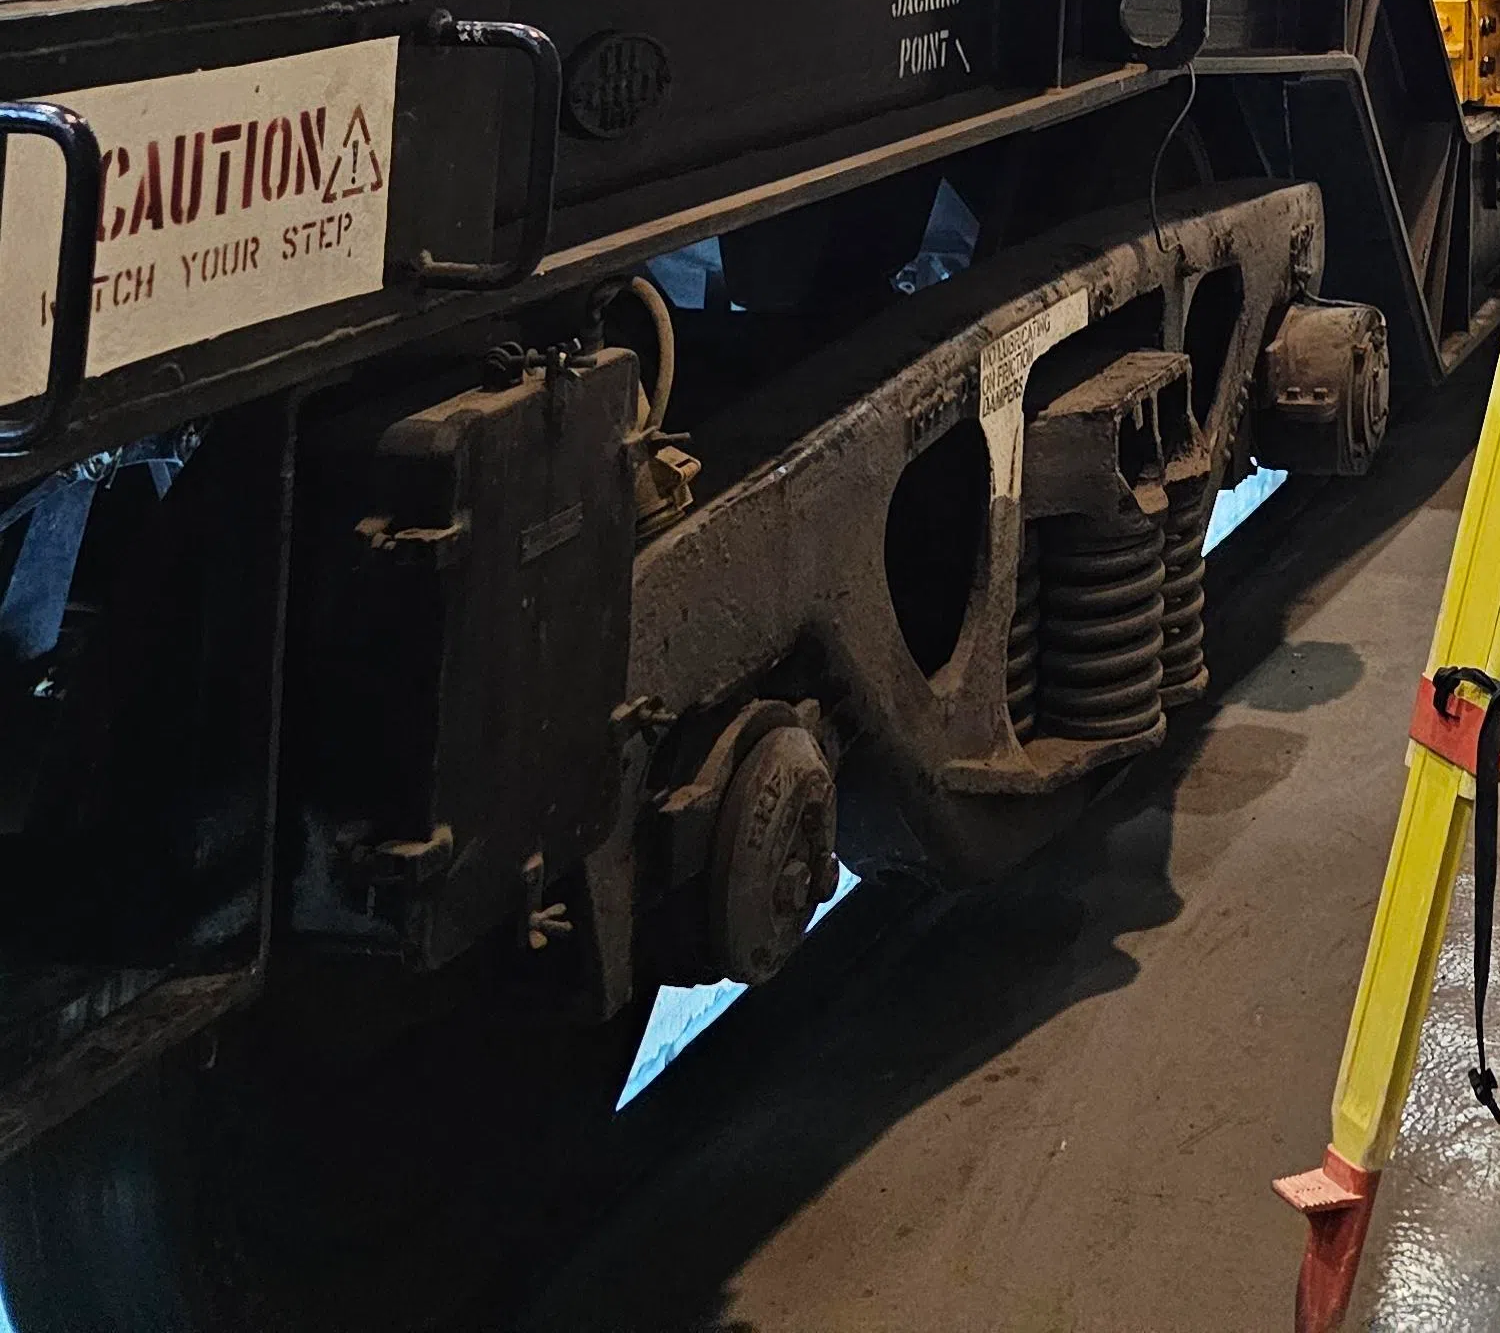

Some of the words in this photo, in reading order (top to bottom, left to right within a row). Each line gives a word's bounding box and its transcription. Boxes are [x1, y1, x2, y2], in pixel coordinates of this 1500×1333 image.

[899, 29, 949, 79] POINT
[97, 106, 327, 242] CAUTION
[182, 236, 261, 289] YOUR
[282, 211, 353, 261] STEP
